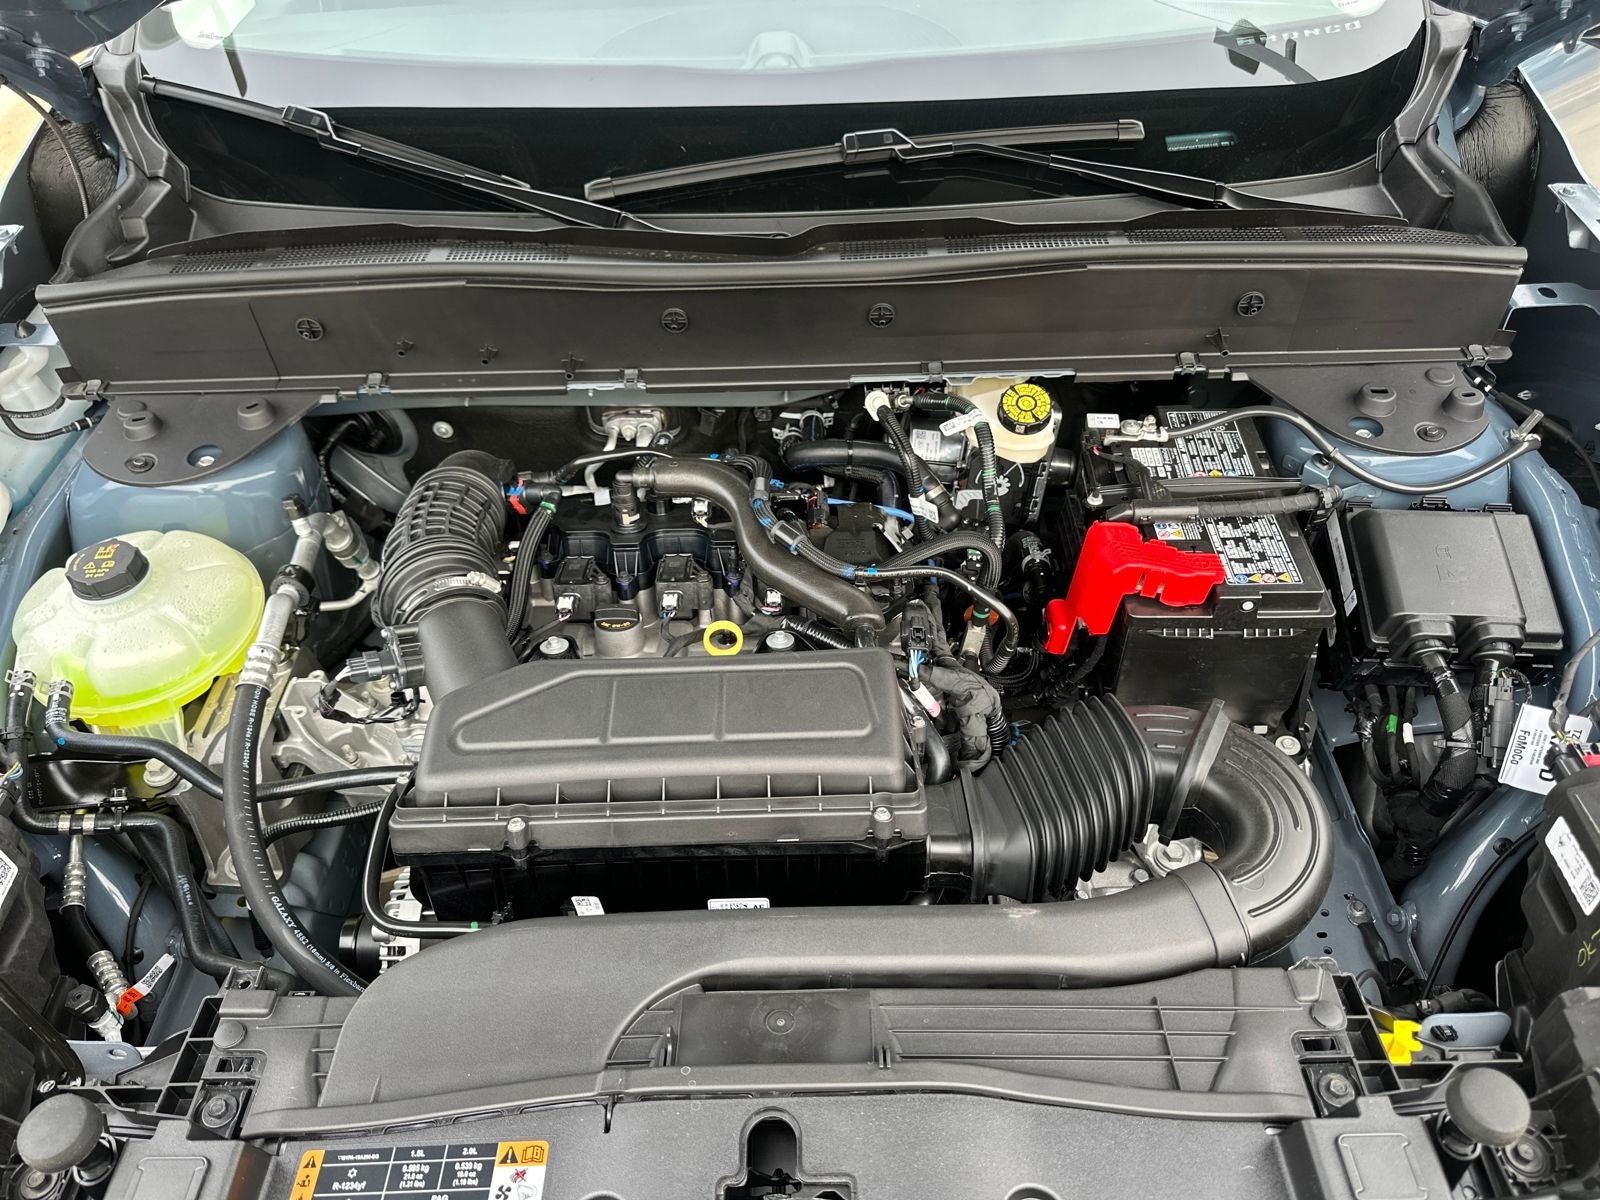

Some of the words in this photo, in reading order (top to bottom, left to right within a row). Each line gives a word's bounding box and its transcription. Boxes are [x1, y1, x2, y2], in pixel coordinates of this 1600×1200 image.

[1510, 729, 1531, 765] FoMoCo
[271, 896, 297, 928] GALAXY
[473, 1161, 483, 1171] kg
